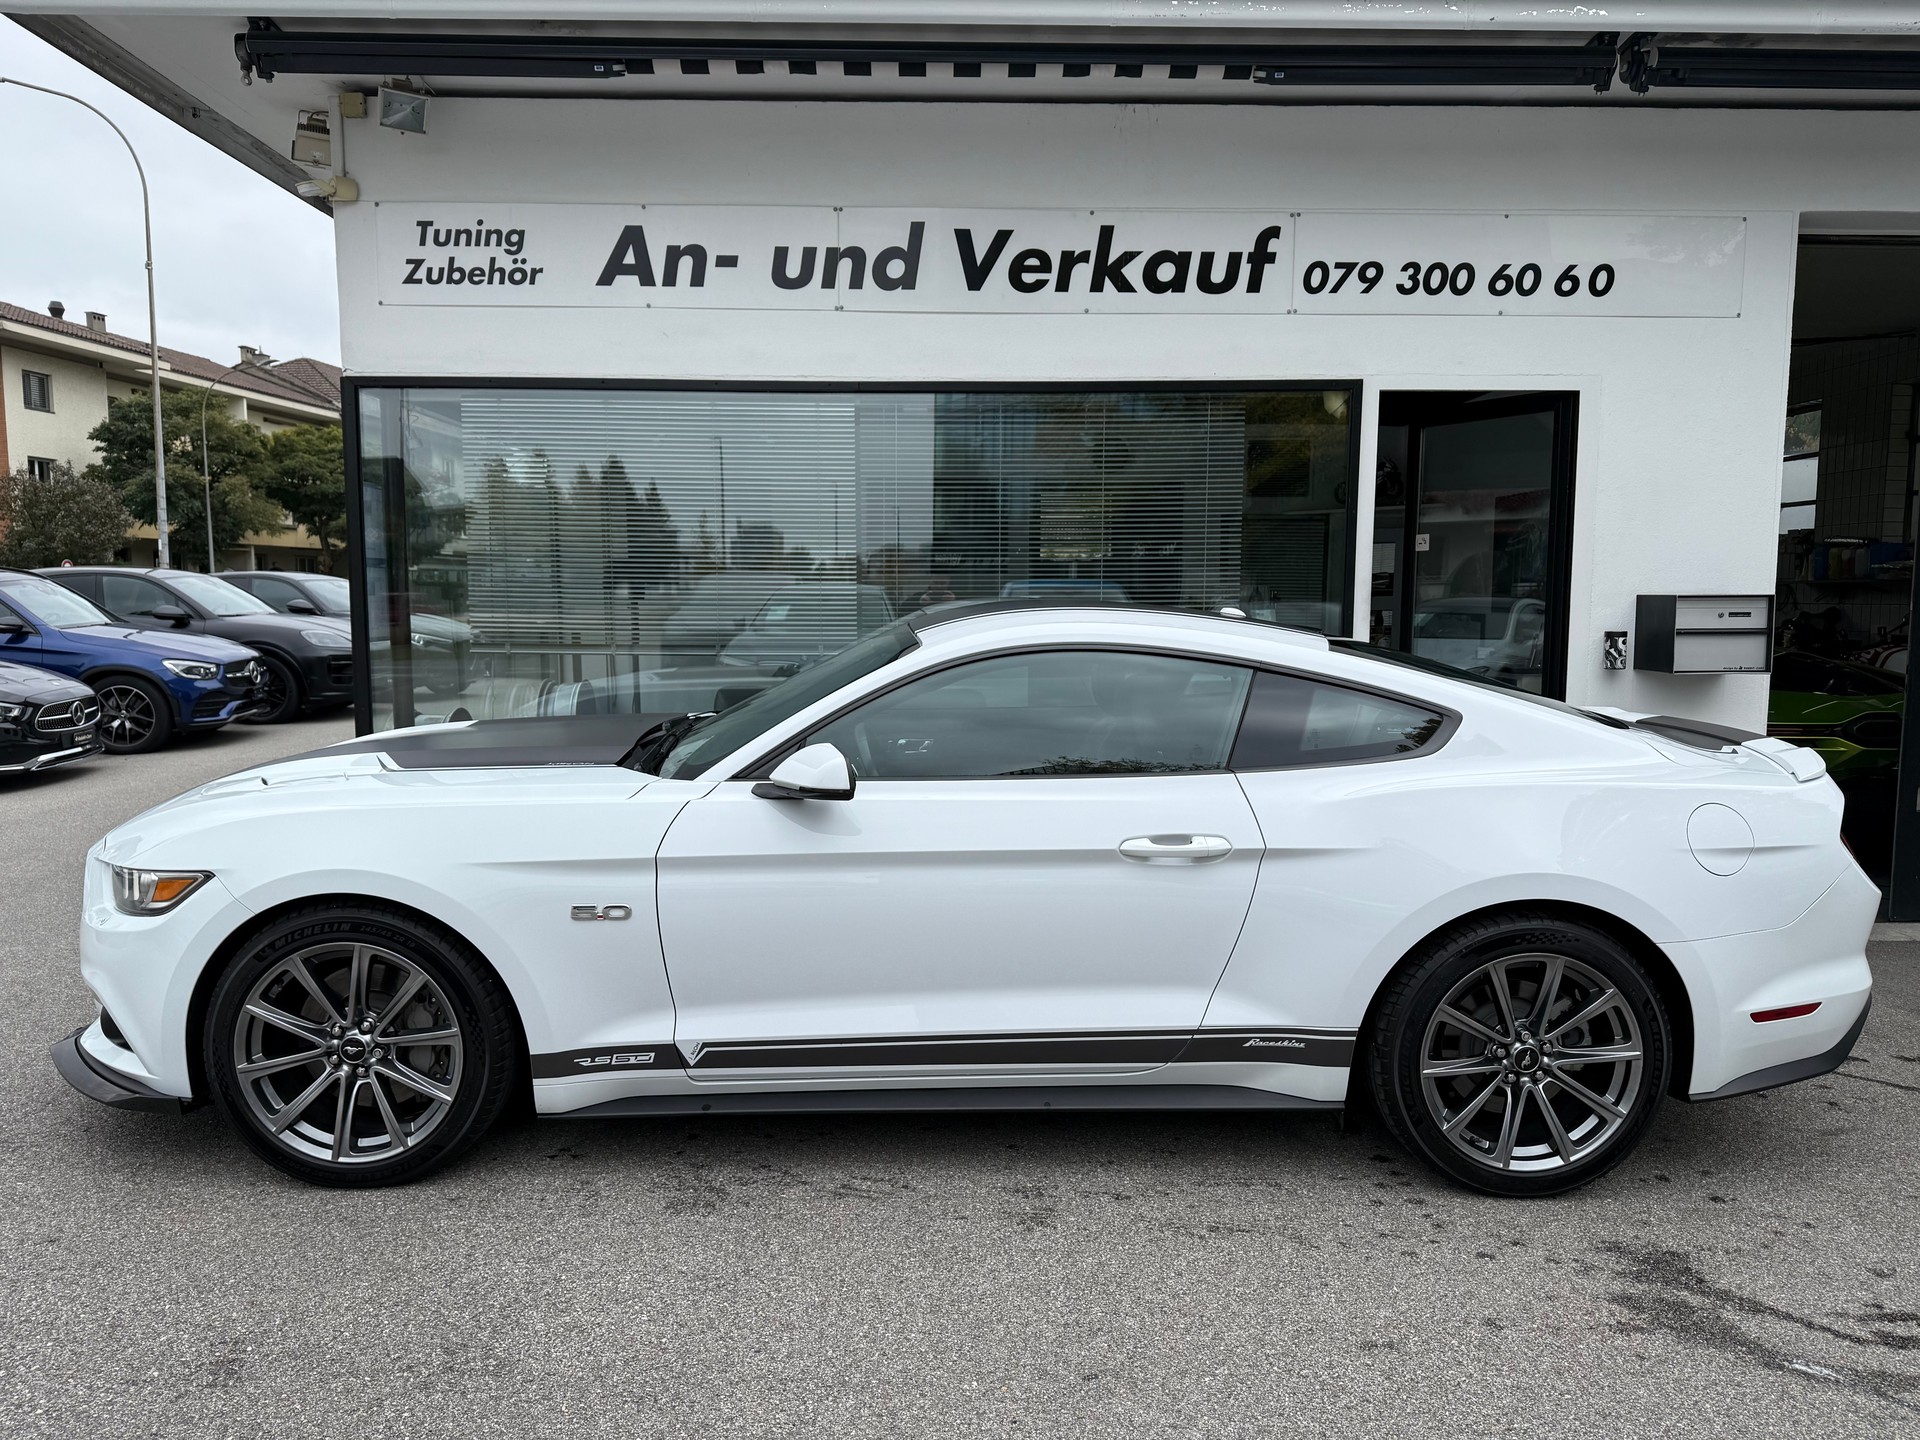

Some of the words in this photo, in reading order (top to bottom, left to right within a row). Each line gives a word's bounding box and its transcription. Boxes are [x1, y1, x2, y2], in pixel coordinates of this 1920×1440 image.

[415, 219, 526, 256] Tuning
[401, 256, 544, 286] Zubehör
[595, 224, 739, 288] An-
[771, 222, 926, 292] und
[953, 224, 1282, 295] Verkauf
[1302, 260, 1384, 295] 079
[1395, 261, 1476, 297] 300
[1487, 262, 1542, 297] 60
[570, 903, 632, 921] 5.0
[274, 922, 351, 948] MICHELIN
